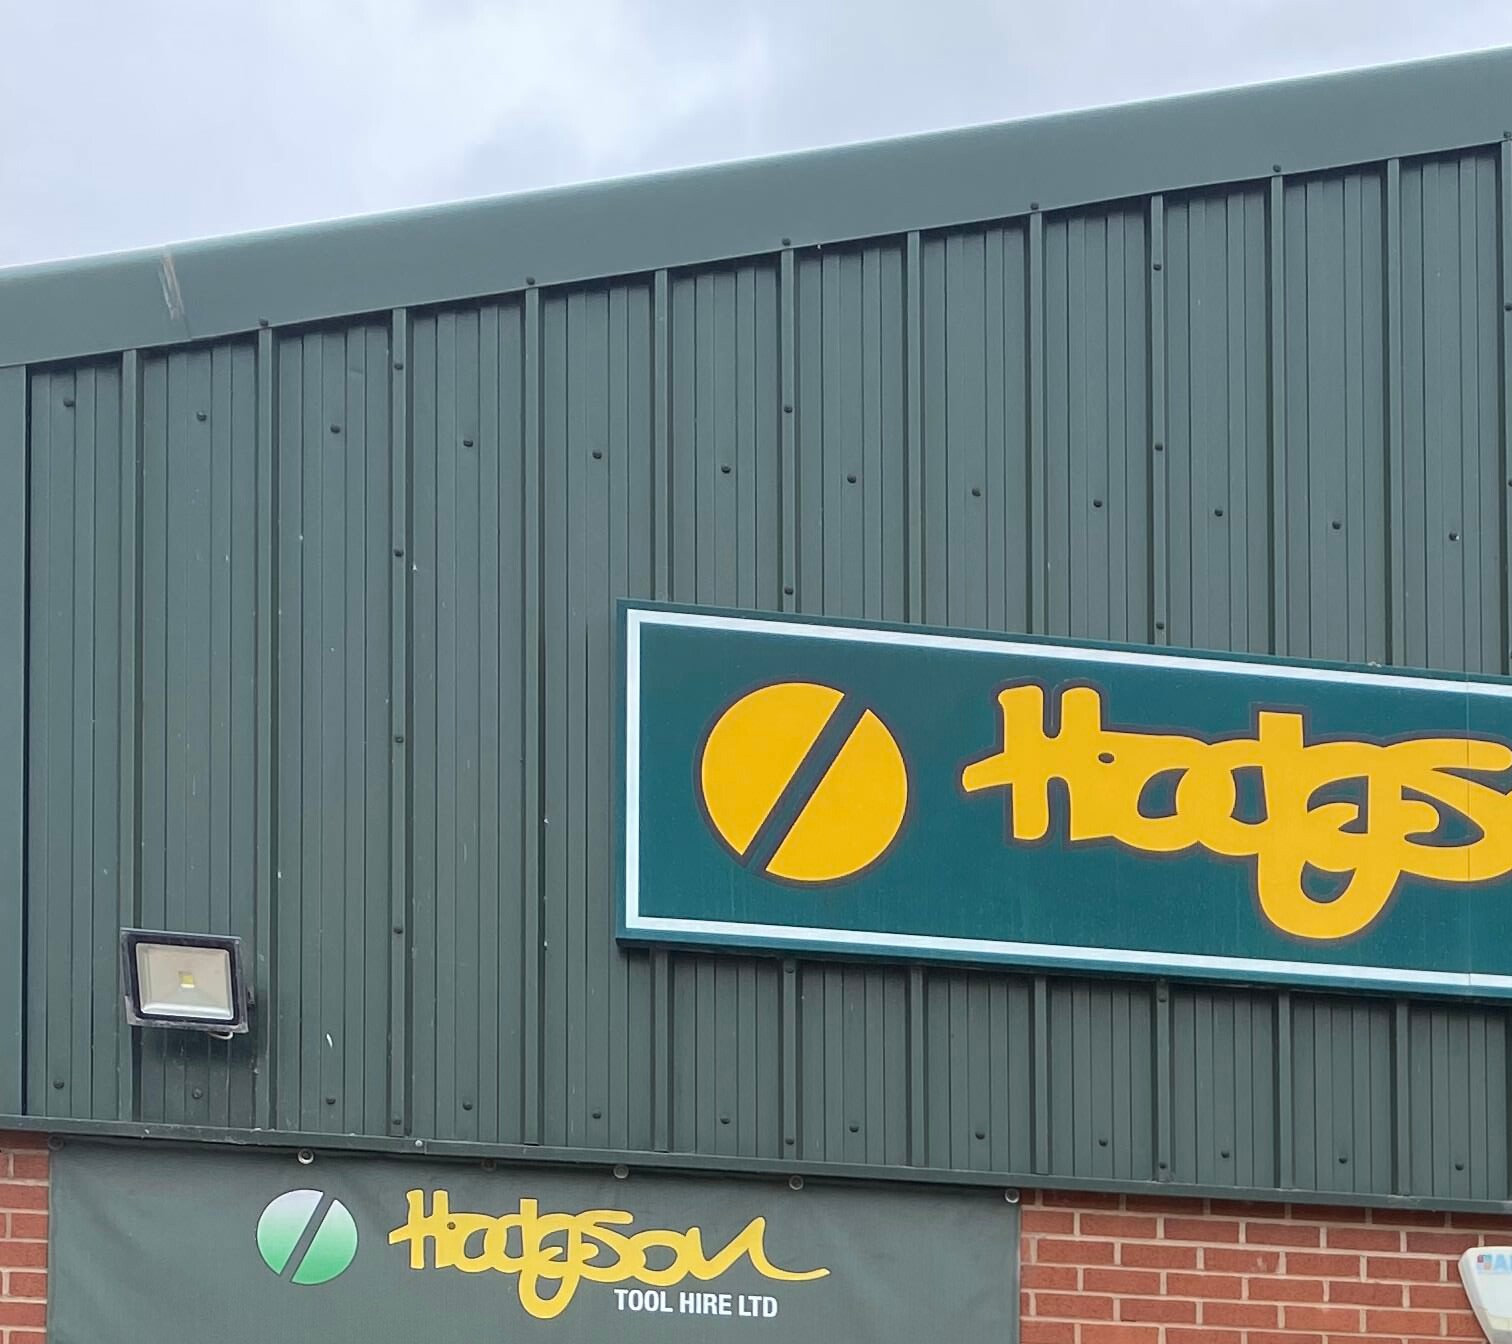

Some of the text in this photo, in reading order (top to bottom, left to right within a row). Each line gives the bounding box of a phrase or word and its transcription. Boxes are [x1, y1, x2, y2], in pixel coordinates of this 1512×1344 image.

[389, 1189, 830, 1319] Hodgson
[613, 1288, 778, 1319] TOOL HIRE LTD
